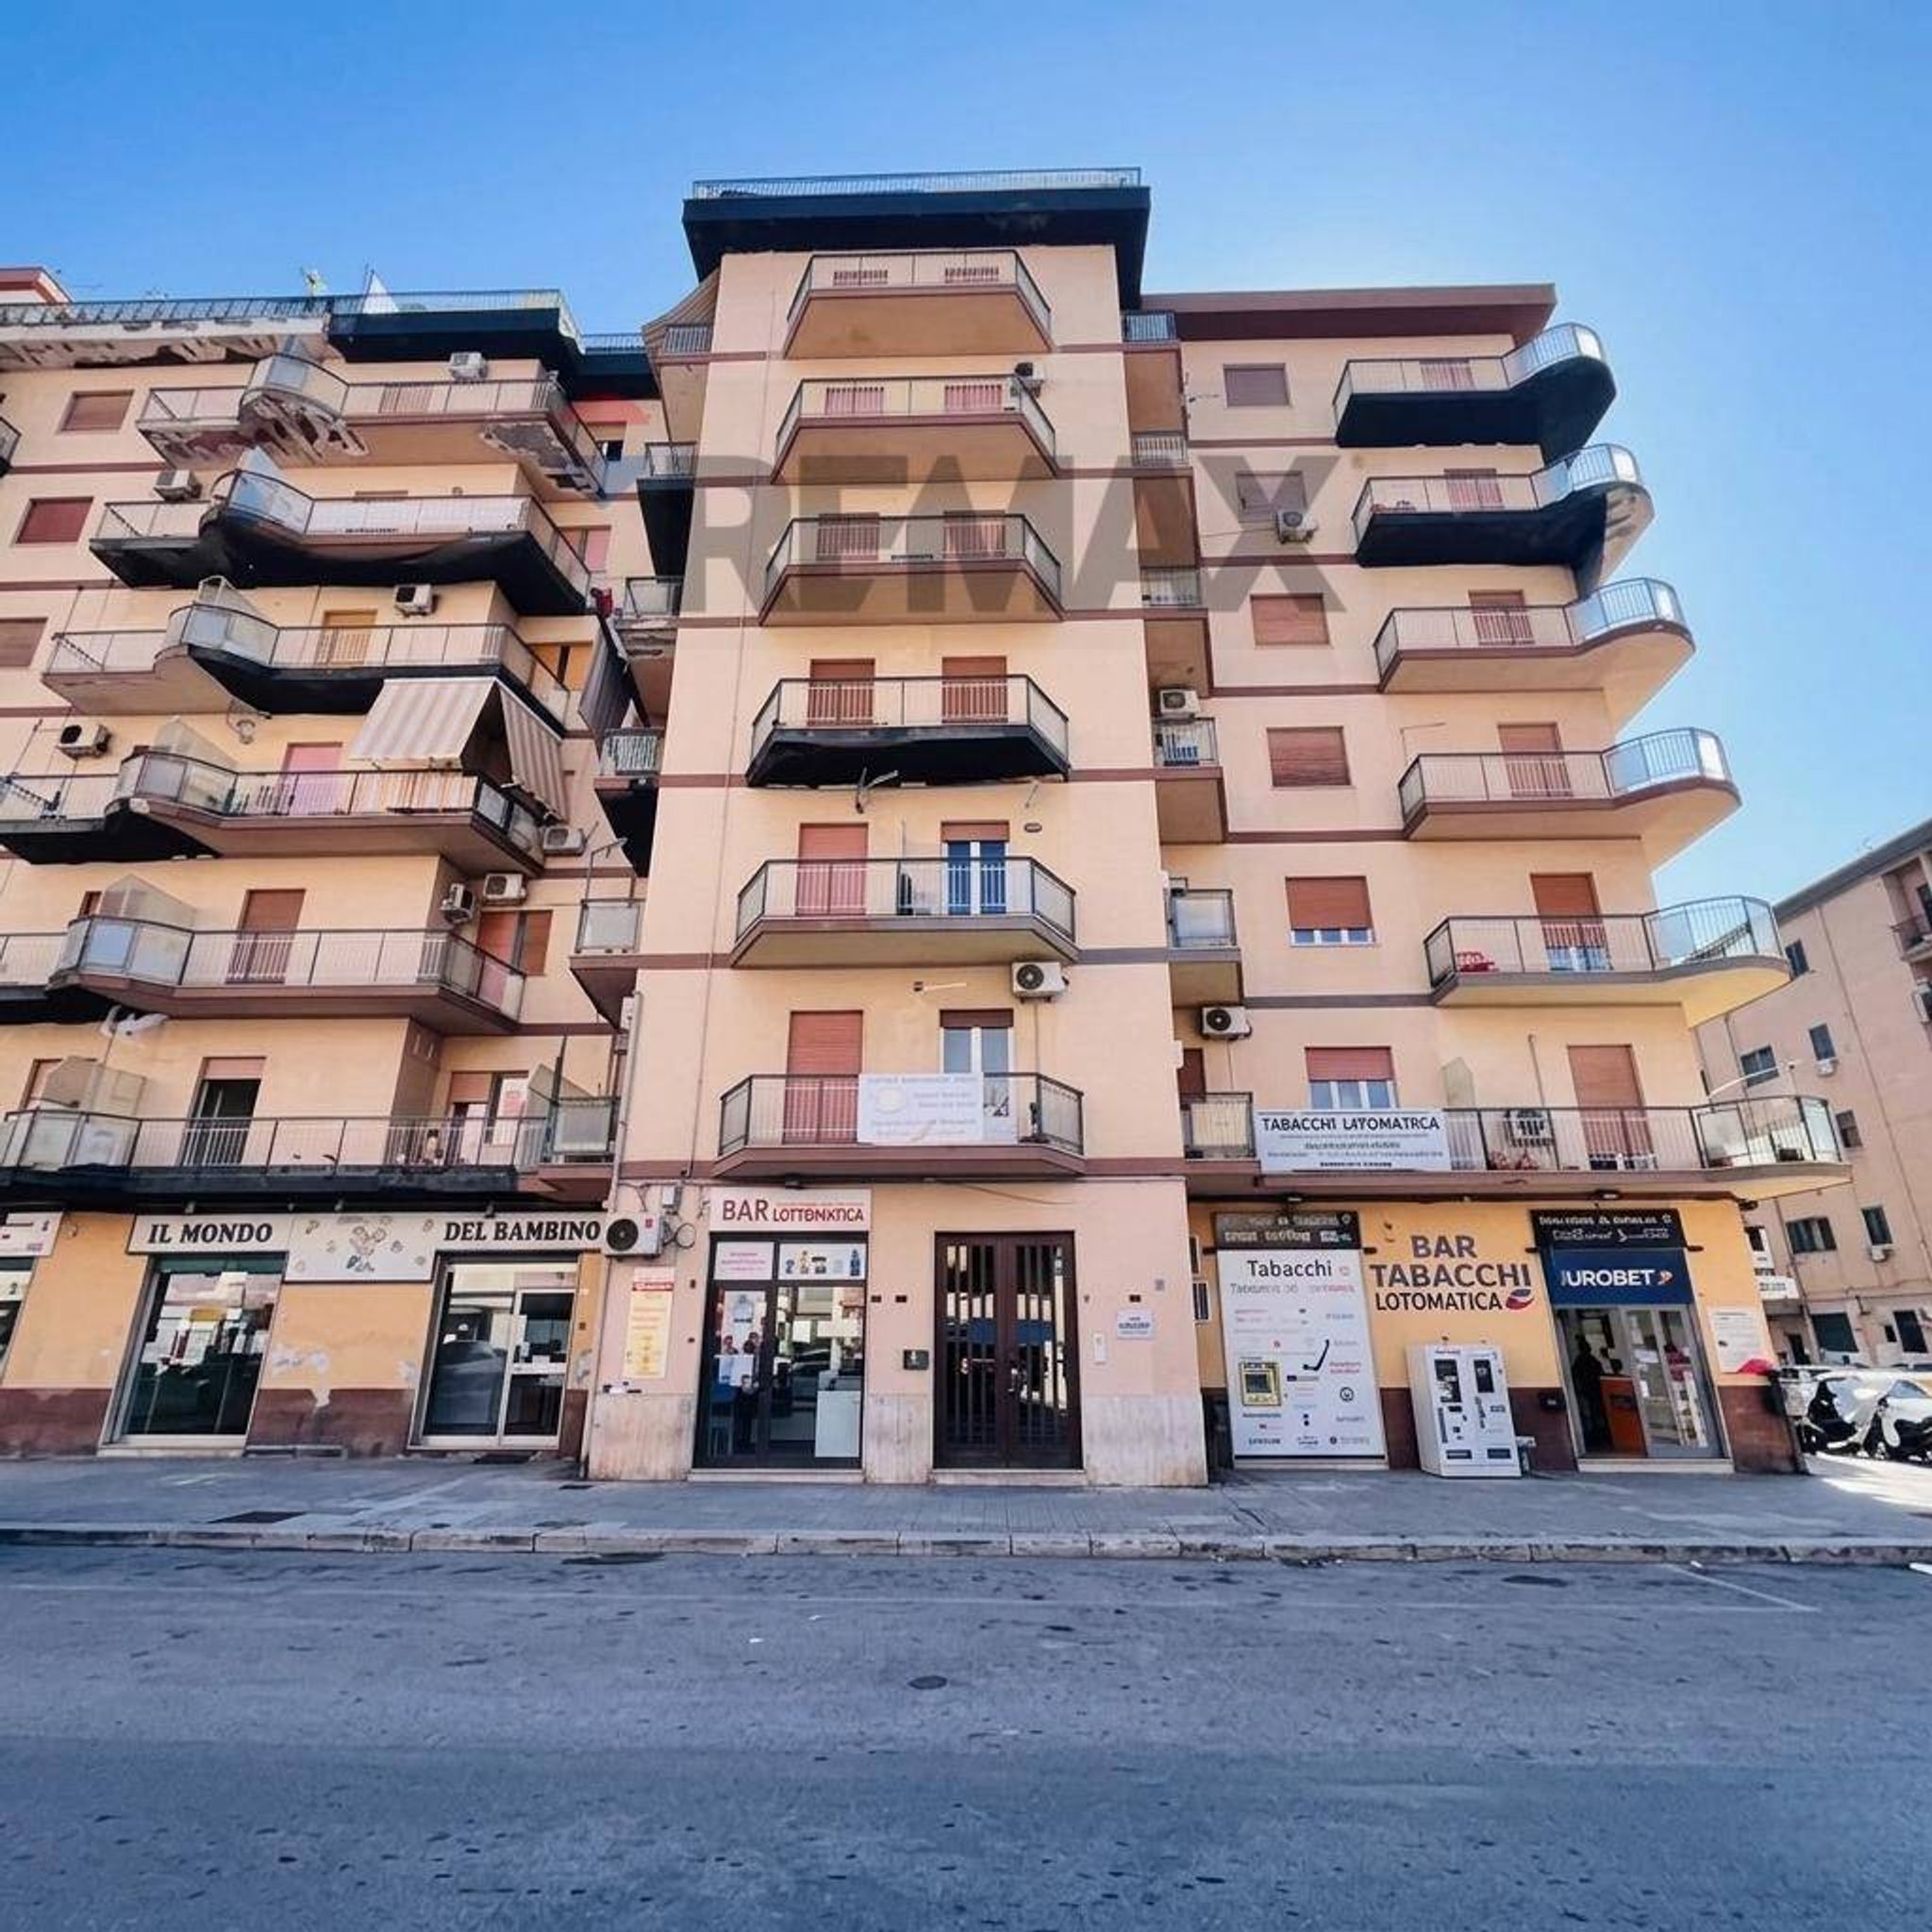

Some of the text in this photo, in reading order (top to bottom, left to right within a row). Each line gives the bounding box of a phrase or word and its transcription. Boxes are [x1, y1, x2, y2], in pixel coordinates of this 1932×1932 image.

[723, 1200, 769, 1221] BAR
[148, 1223, 274, 1243] IL MONDO
[444, 1221, 601, 1241] DEL BAMBINO
[1411, 1235, 1477, 1258] BAR
[1247, 1259, 1332, 1277] Tabacchi
[1369, 1263, 1532, 1287] TABACCHI
[1375, 1292, 1503, 1310] LOTOMATICA
